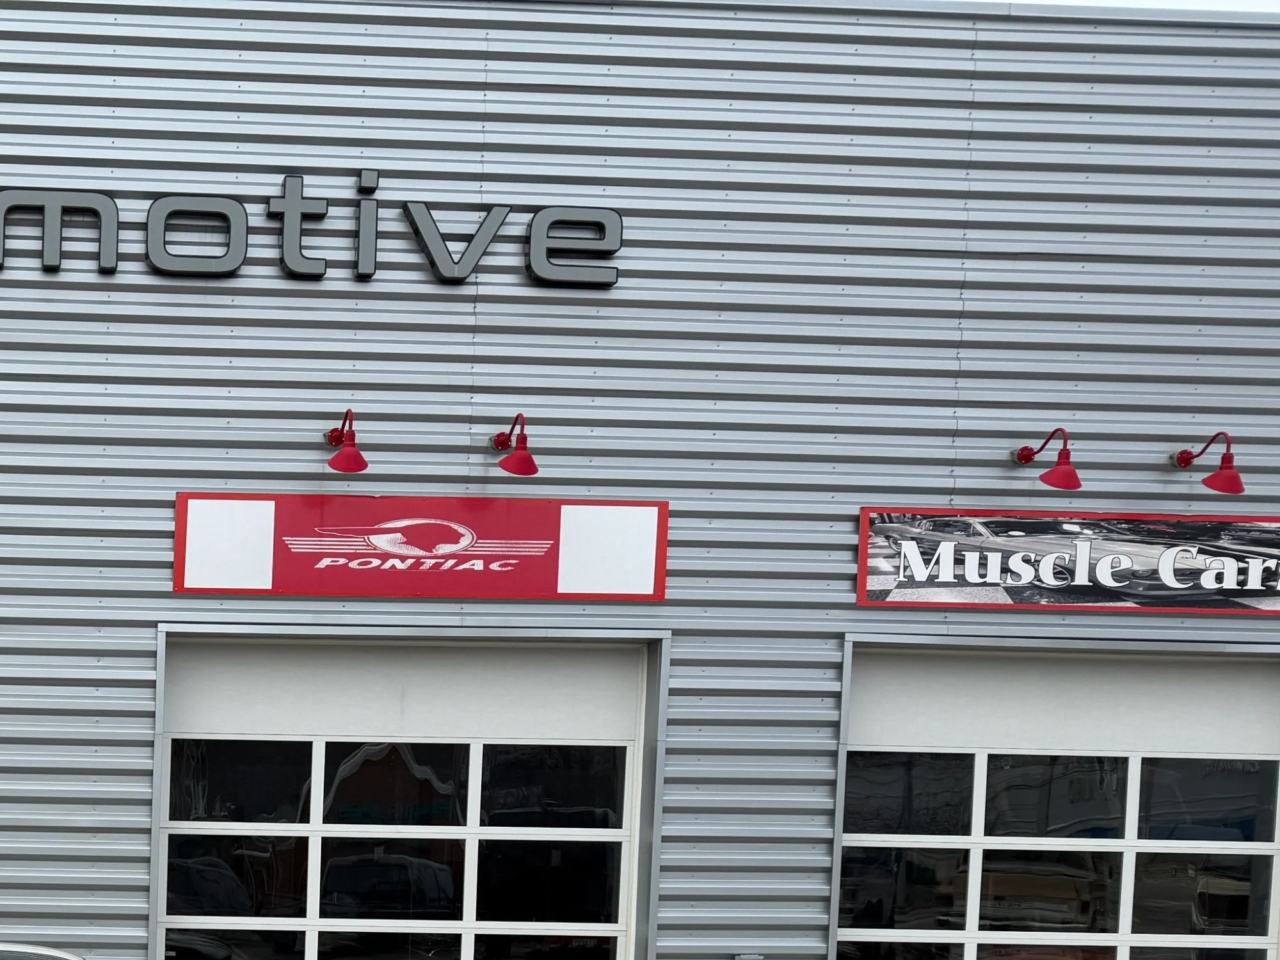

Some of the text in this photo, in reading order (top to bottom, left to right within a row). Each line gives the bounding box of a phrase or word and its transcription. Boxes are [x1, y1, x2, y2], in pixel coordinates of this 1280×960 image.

[314, 557, 520, 572] PONTIAC
[895, 540, 1280, 590] Muscle Car
